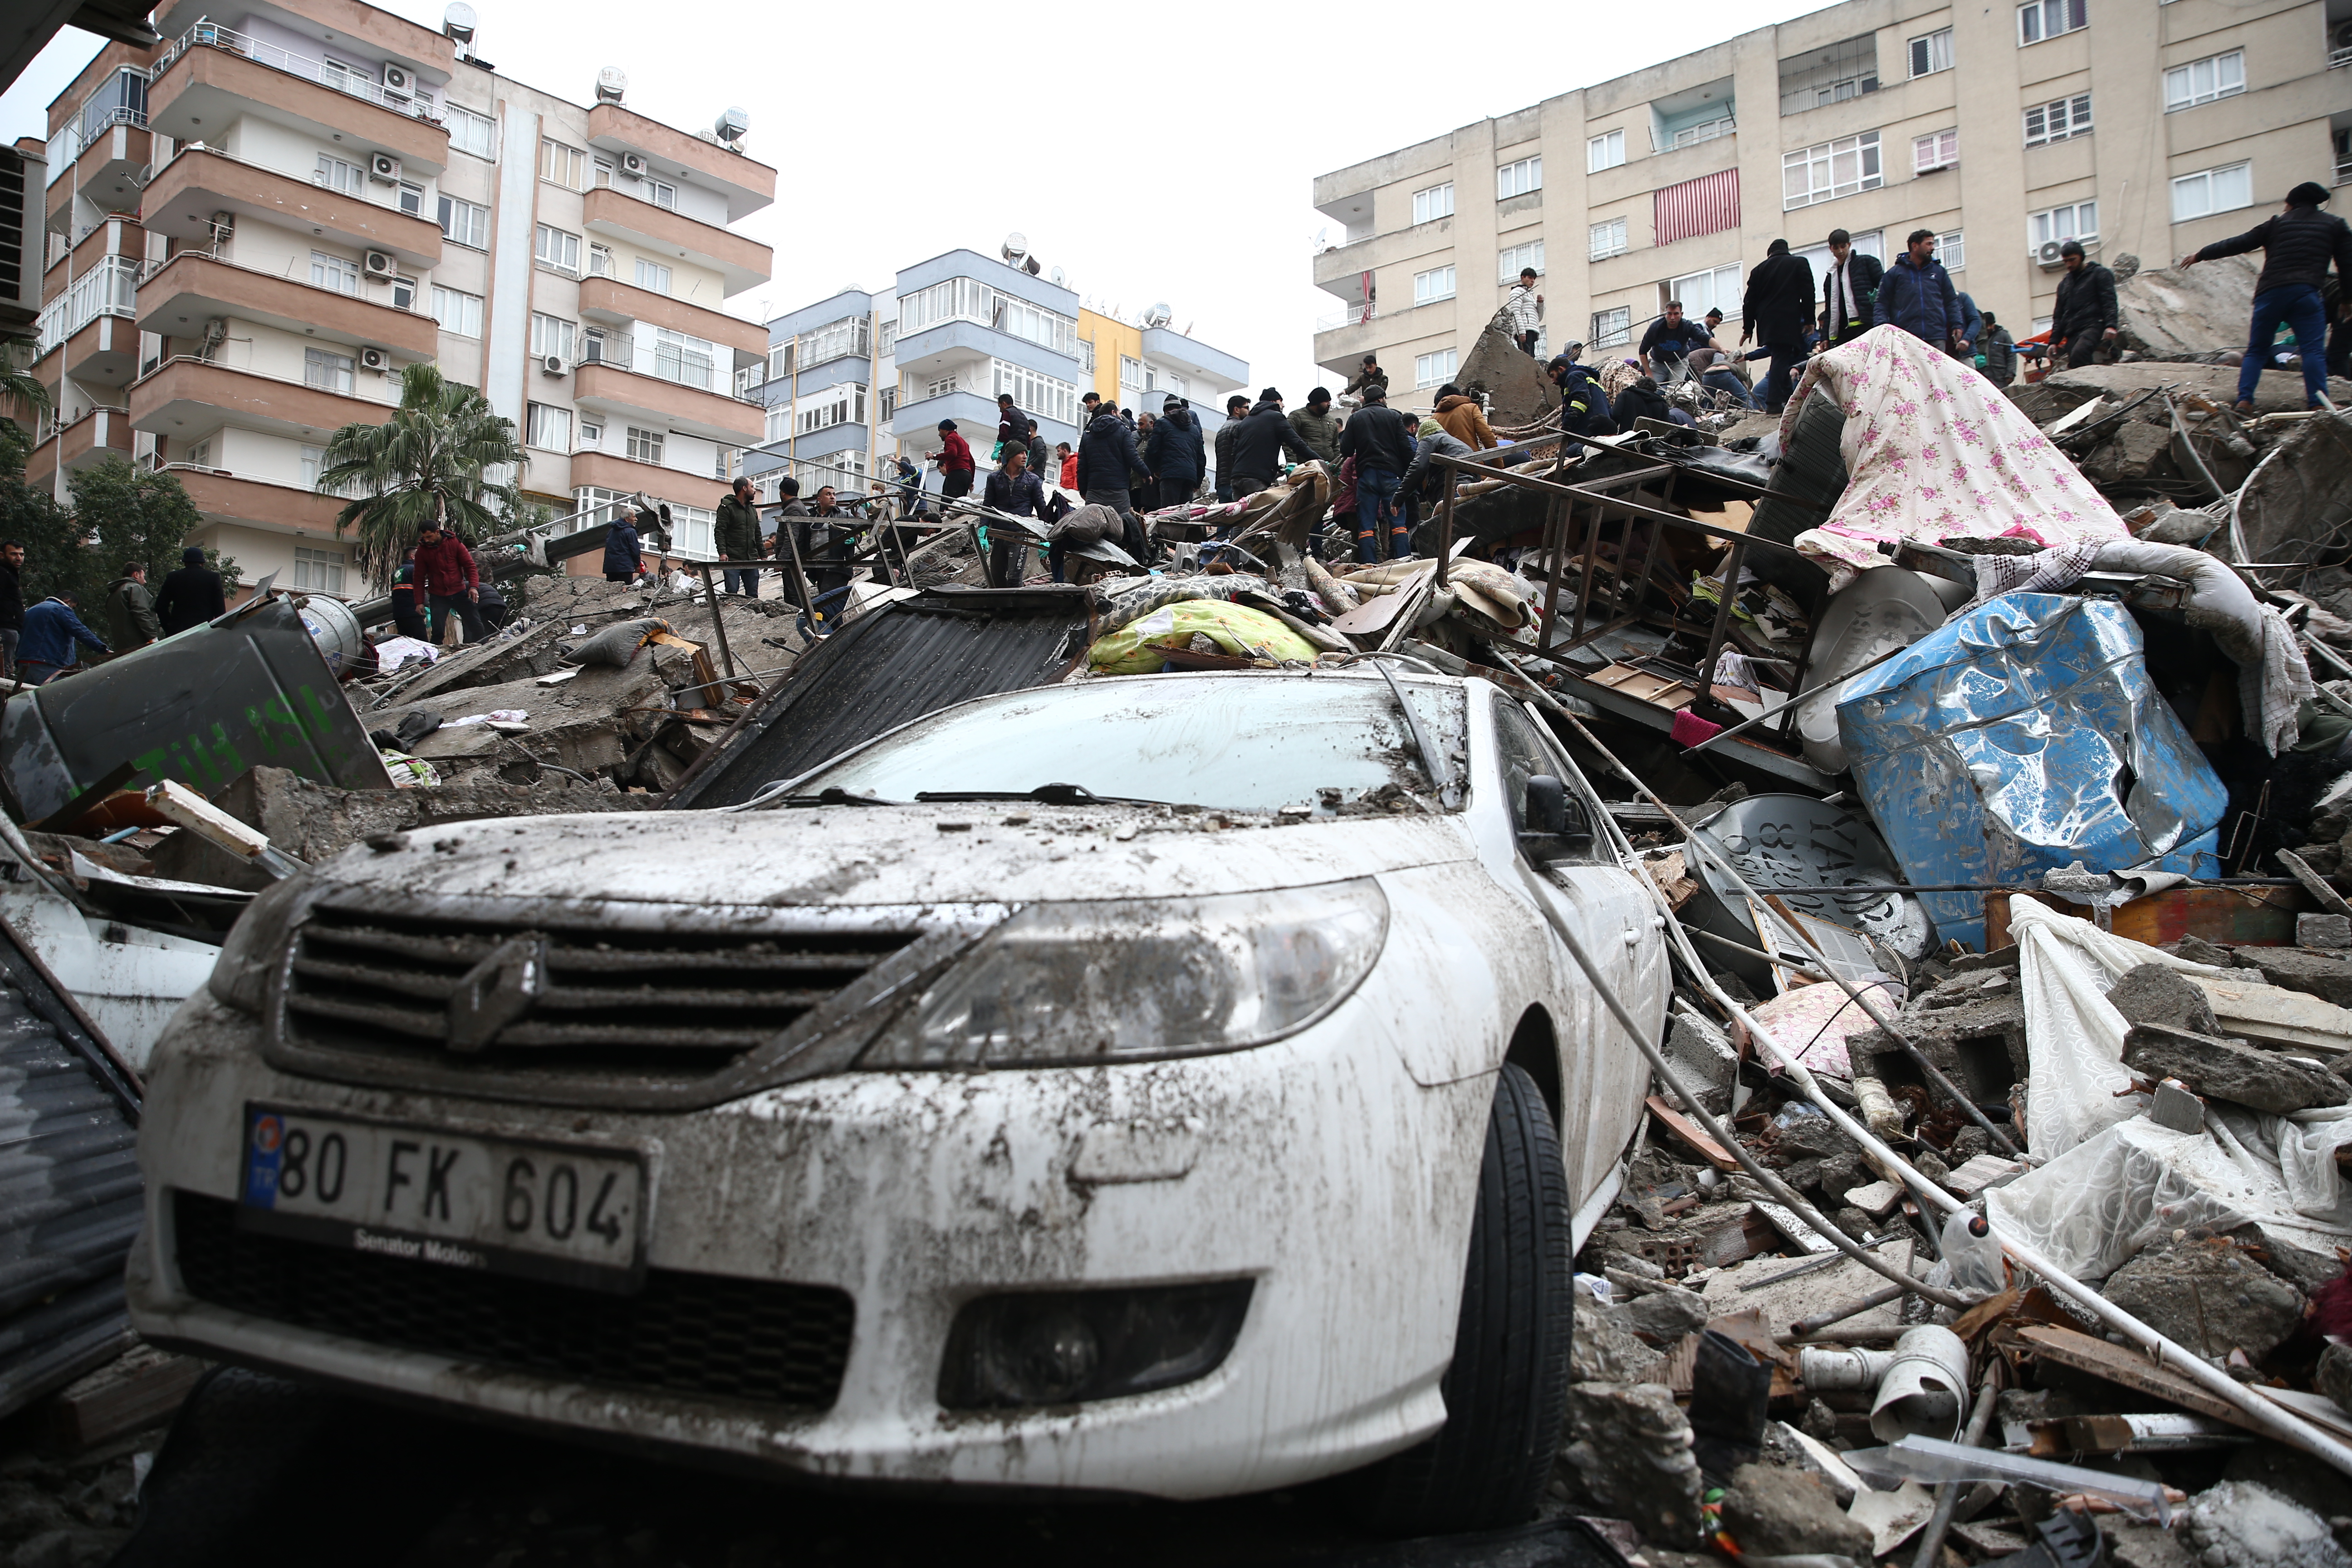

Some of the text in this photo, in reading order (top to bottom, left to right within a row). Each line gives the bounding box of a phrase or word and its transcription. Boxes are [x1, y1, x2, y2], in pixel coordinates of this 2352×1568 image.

[279, 1128, 621, 1245] 80 FK 604
[354, 1228, 489, 1268] Senator Motors
